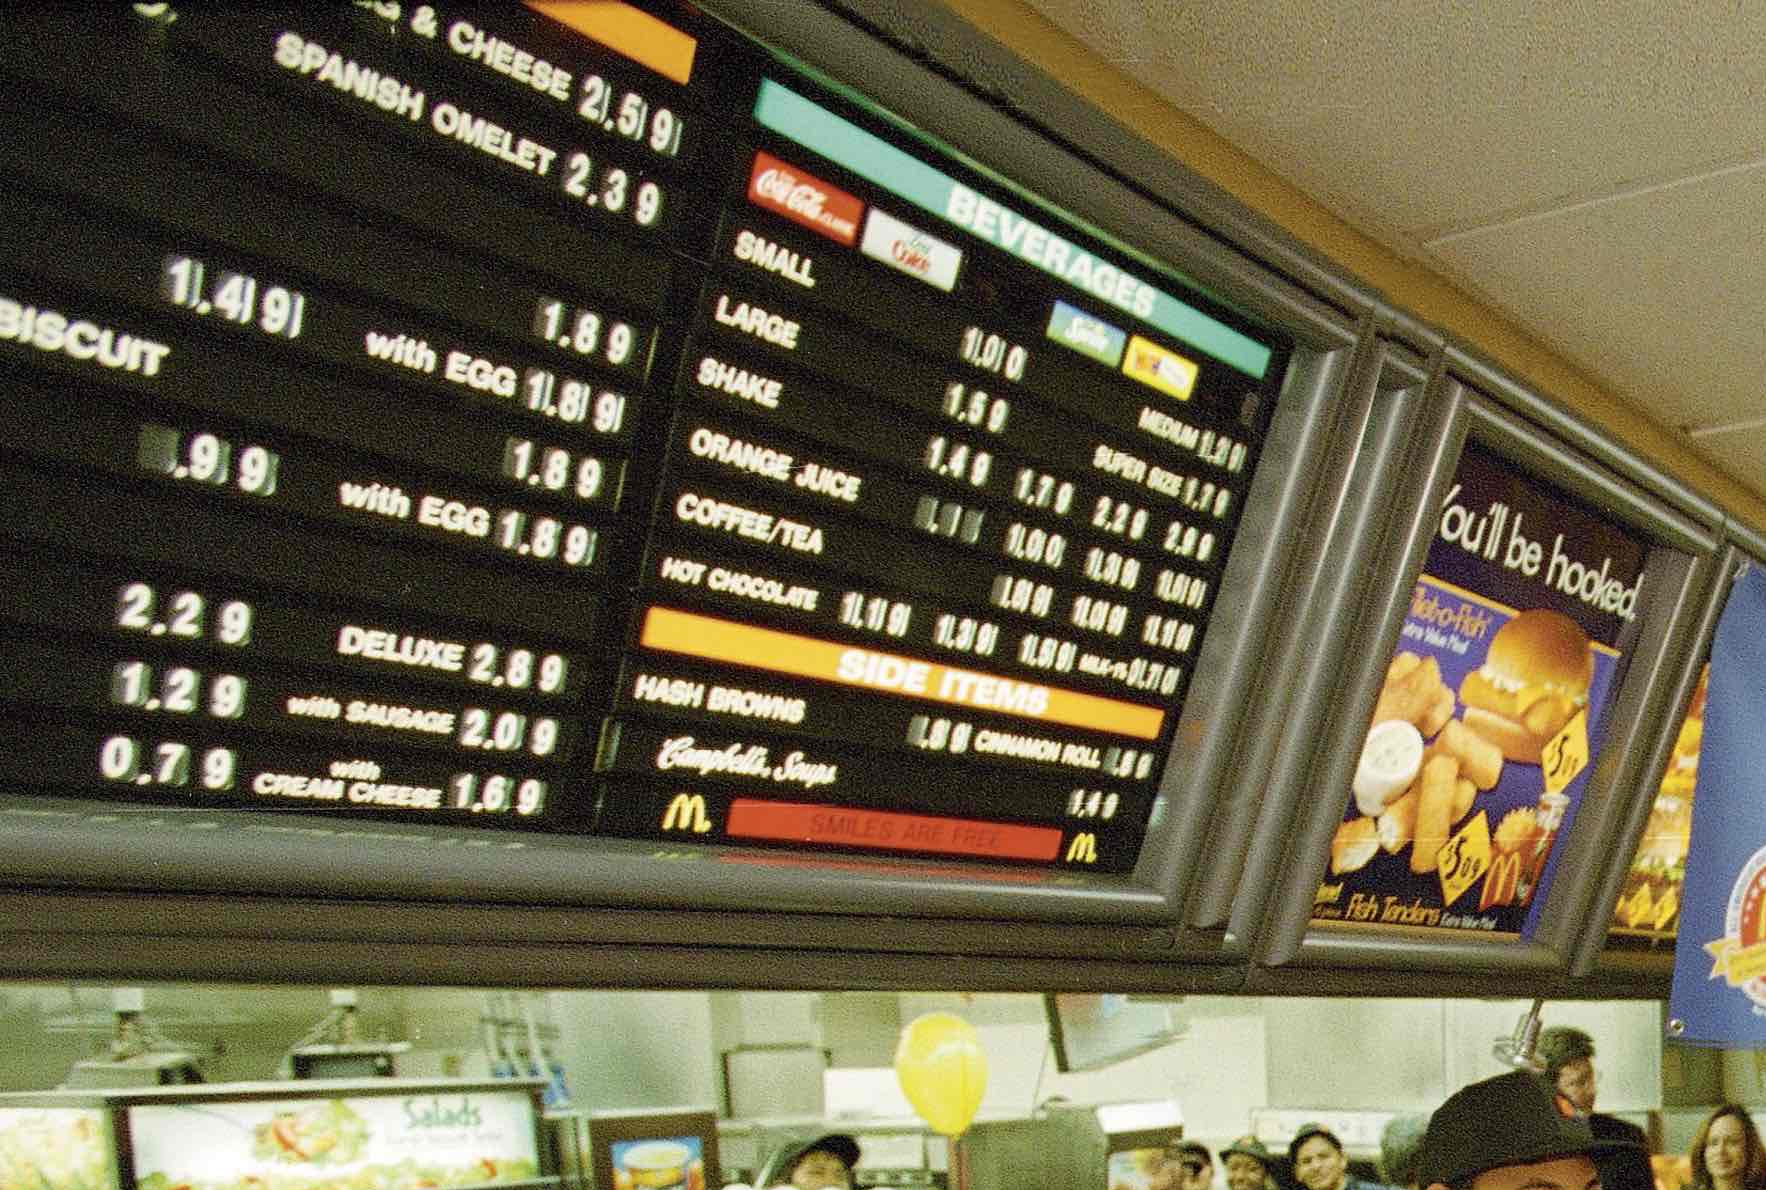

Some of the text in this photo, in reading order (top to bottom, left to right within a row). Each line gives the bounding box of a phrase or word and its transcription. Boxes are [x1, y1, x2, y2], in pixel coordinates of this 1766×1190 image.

[449, 21, 573, 101] CHEESE
[274, 32, 661, 226] SPANISH OMELET 2.39
[733, 231, 816, 288] SMALL
[946, 181, 1155, 317] BEVERAGES
[714, 295, 800, 350] LARGE
[365, 332, 436, 374] with
[444, 353, 518, 398] EGG
[697, 357, 783, 411] SHAKE
[1137, 407, 1200, 450] MEDIUM
[690, 428, 862, 502] ORANGE JUICE
[339, 482, 411, 520] with
[417, 496, 490, 537] EGG
[675, 494, 825, 555] COFFEE/TEA
[660, 557, 820, 612] HOT CHOCOLATE
[1503, 513, 1543, 576] be
[1546, 533, 1645, 623] hooked.
[116, 583, 252, 646] 2.29
[338, 626, 466, 672] DELUXE
[113, 661, 246, 718] 1.29
[837, 648, 1050, 717] SIDE ITEMS
[288, 696, 341, 721] with
[345, 702, 455, 734] SAUSAGE
[634, 674, 705, 709] HASH
[706, 686, 806, 724] BROWNS
[974, 729, 1062, 762] CINNAMON
[1062, 744, 1100, 769] ROLL
[100, 737, 236, 790] 0.79
[253, 773, 346, 803] CREAM
[348, 782, 442, 808] CHEESE
[330, 760, 381, 782] with
[772, 751, 837, 789] Soups
[809, 812, 899, 840] SMILES
[403, 1099, 482, 1130] Salads
